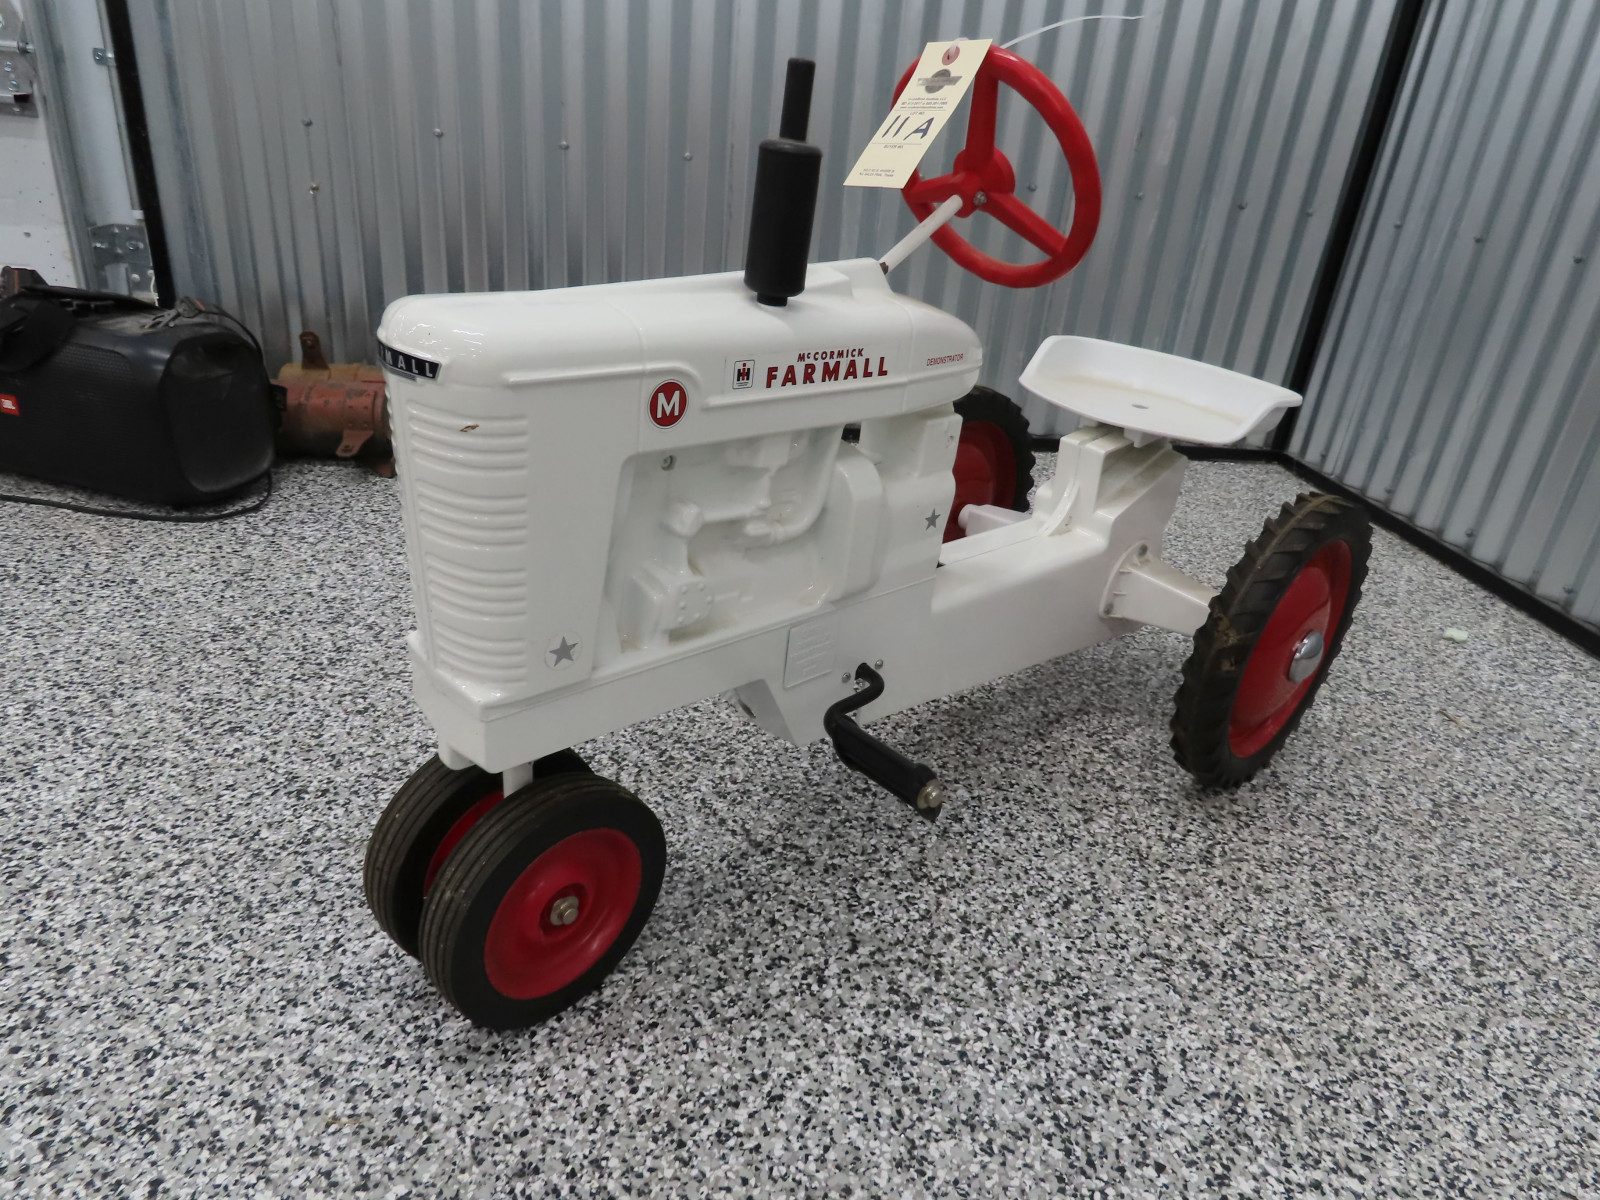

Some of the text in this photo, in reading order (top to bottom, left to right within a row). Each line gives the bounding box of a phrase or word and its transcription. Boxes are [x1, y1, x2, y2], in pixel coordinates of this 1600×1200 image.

[765, 356, 888, 389] FARMALL
[926, 353, 964, 367] DEMONSTRATOR
[656, 390, 681, 420] M
